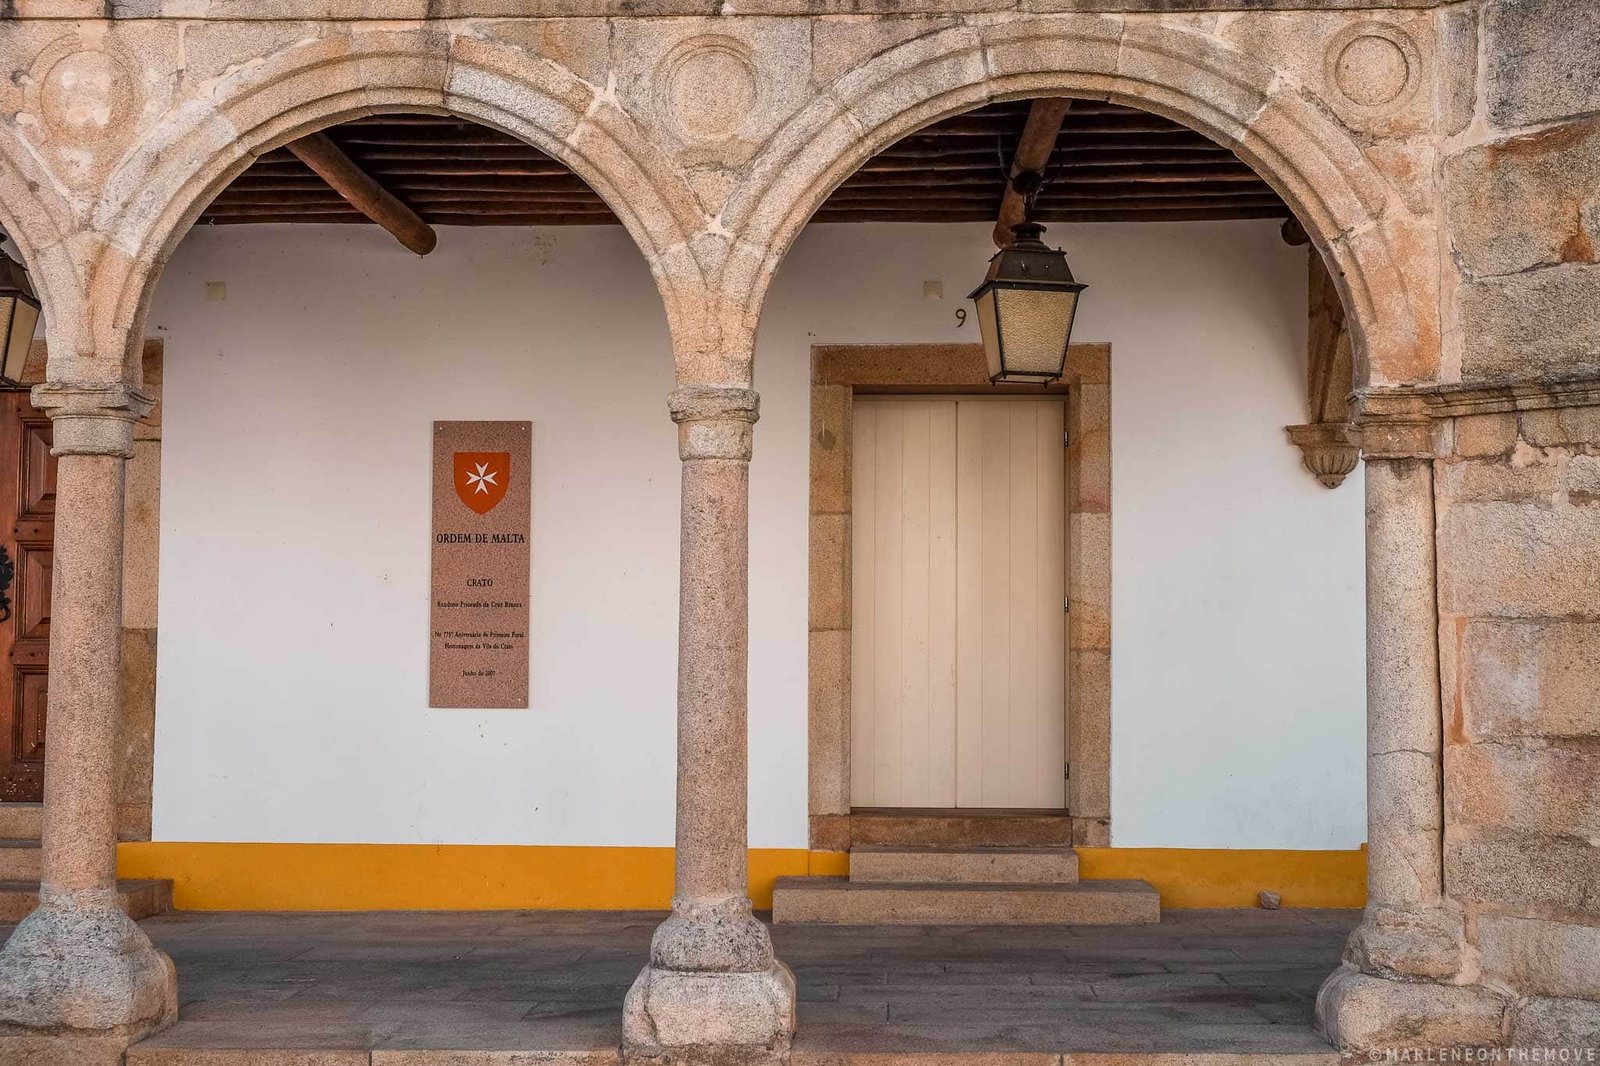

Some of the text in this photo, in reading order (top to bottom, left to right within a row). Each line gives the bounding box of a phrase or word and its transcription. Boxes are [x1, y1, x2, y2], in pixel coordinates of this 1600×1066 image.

[955, 308, 967, 328] 9
[436, 533, 525, 543] ORDEM DE MALTA
[467, 579, 493, 587] CRATO
